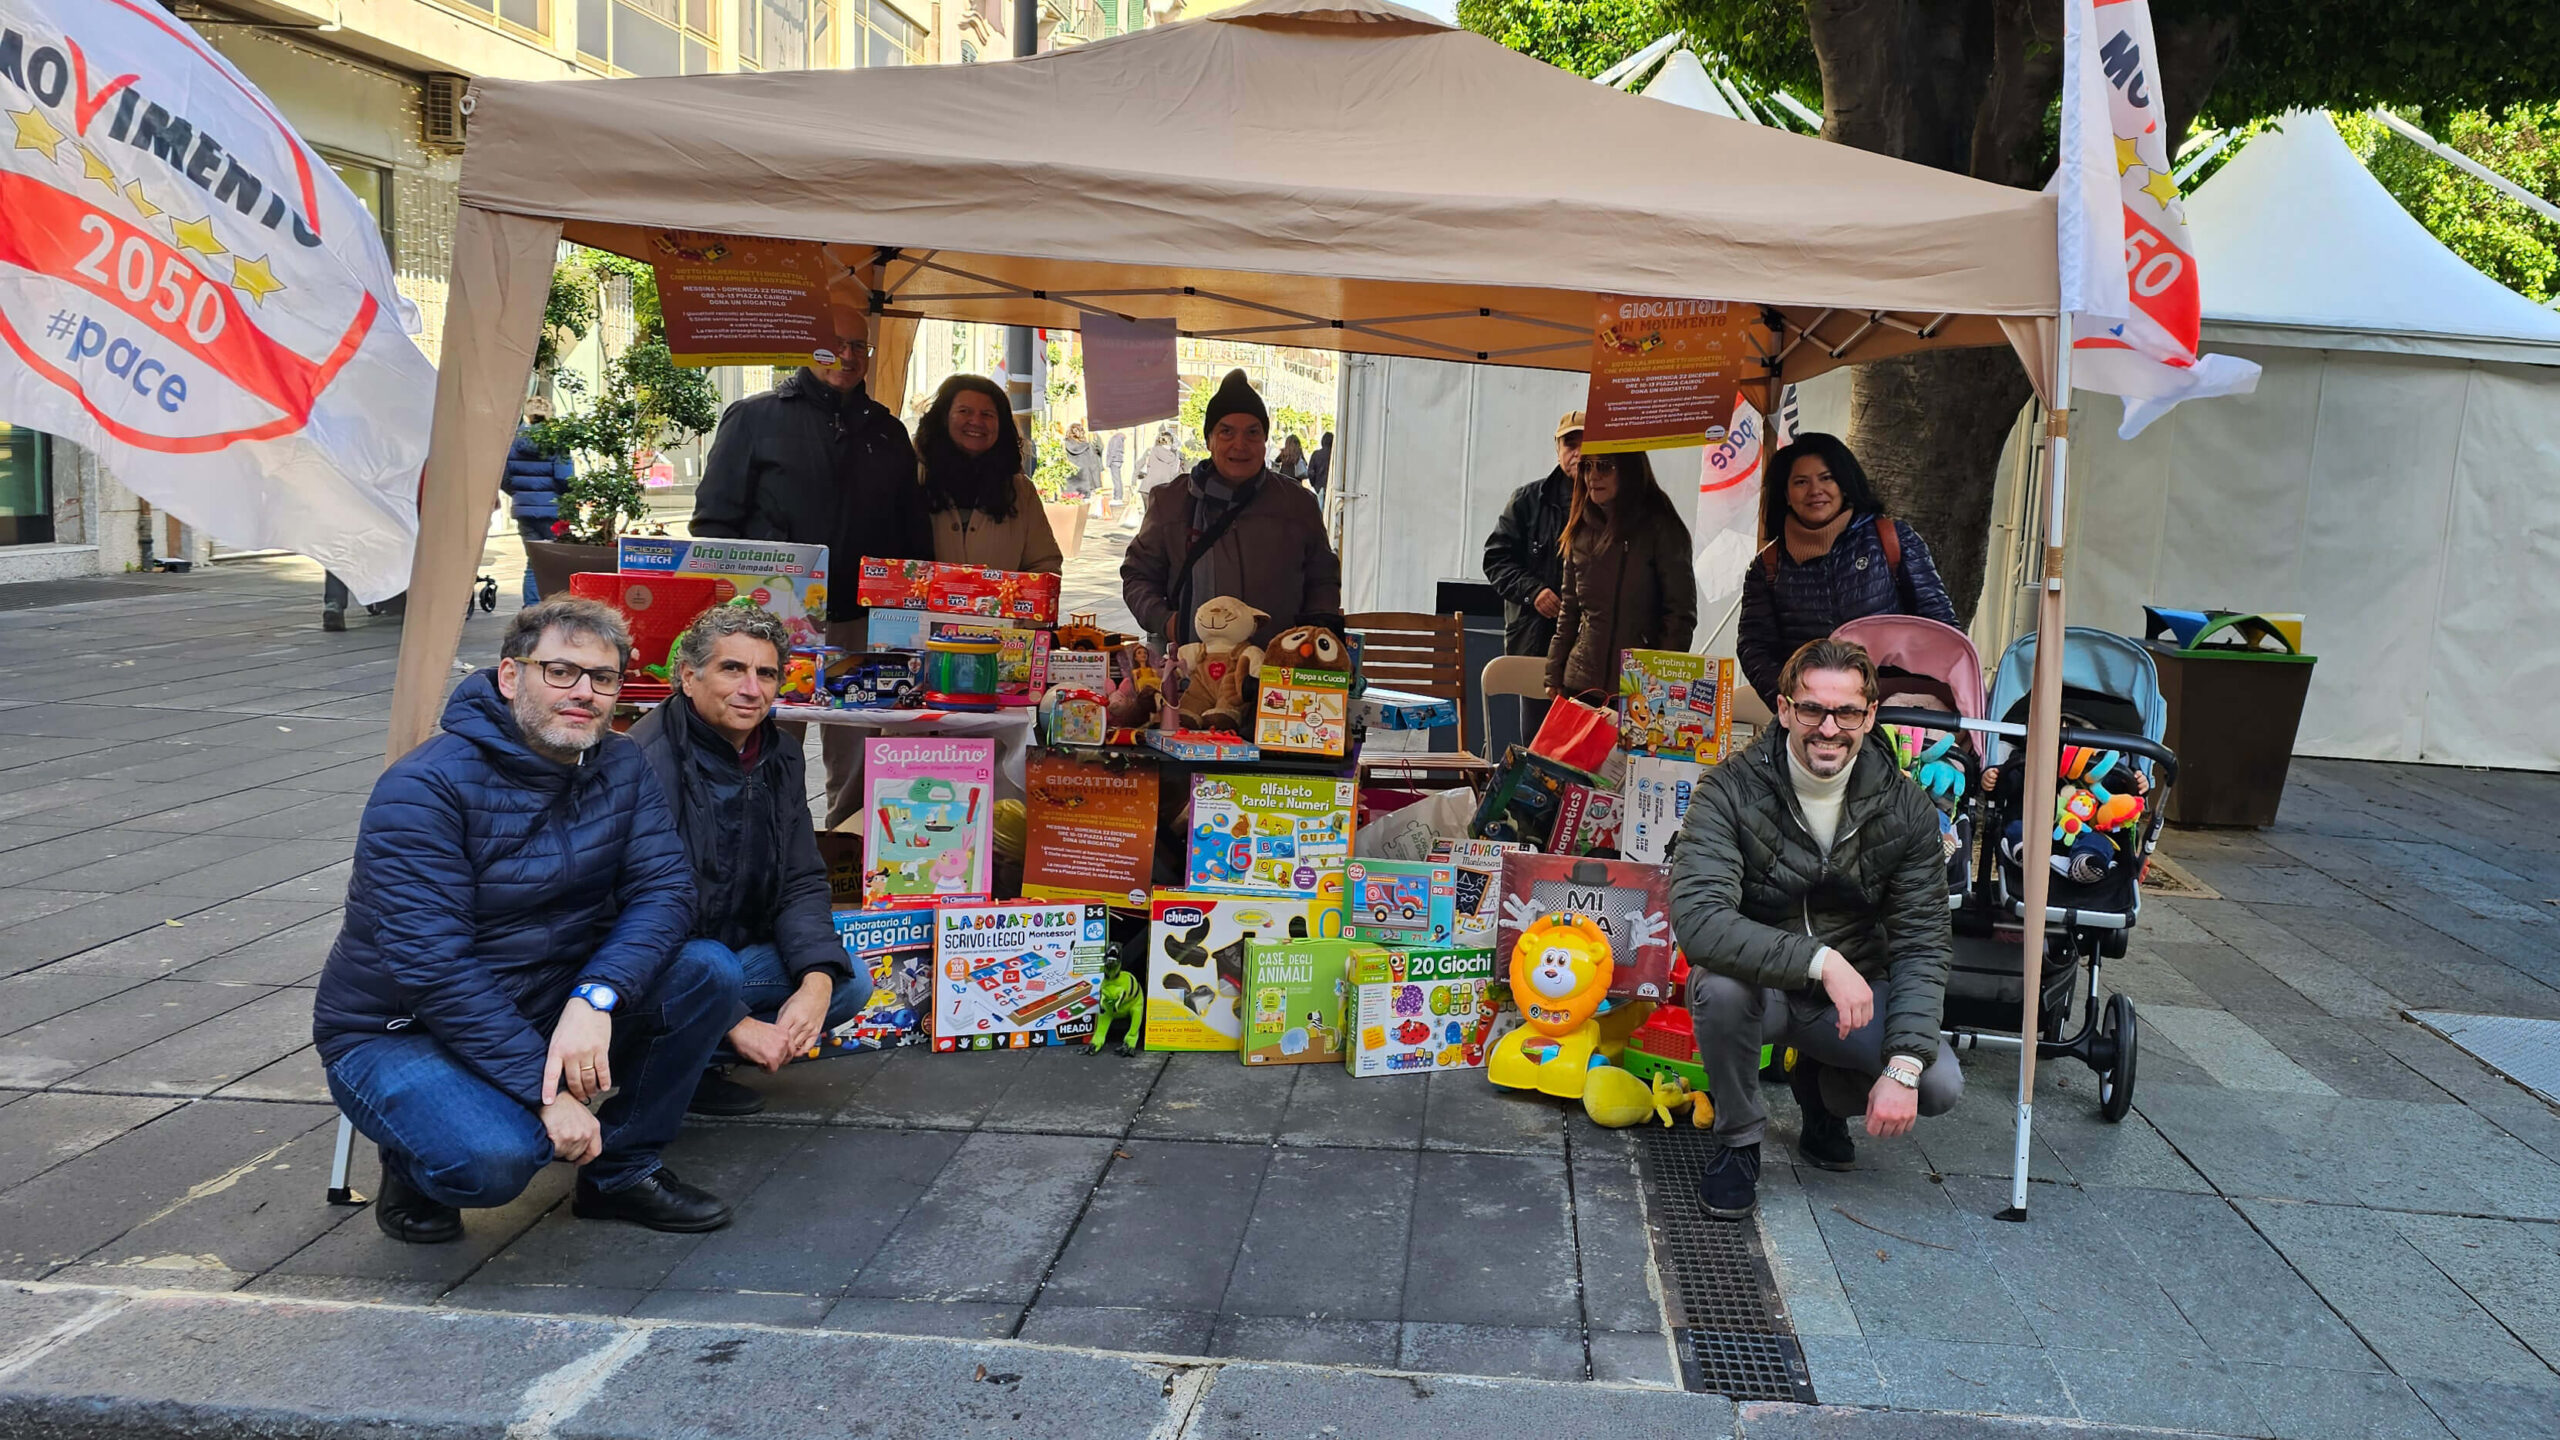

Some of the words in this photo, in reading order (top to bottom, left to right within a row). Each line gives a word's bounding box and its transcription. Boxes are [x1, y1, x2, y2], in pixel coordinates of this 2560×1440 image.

[73, 214, 225, 344] 2050
[1619, 300, 1728, 319] GIOCATTOLI
[1619, 320, 1634, 333] IN
[1640, 315, 1727, 332] MOVIMENTO
[46, 309, 187, 413] #pace
[624, 545, 673, 554] SCIENZA
[692, 545, 722, 559] Orto
[729, 546, 796, 563] botanico
[719, 563, 736, 571] con
[737, 562, 774, 573] lampada
[775, 564, 804, 574] LED
[1049, 654, 1104, 663] SILLABANDO
[1653, 656, 1686, 667] Carotina
[1295, 672, 1317, 681] Pappa
[1322, 674, 1346, 683] Cuccia
[1662, 667, 1692, 680] Londra
[873, 743, 987, 768] Sapientino
[1046, 775, 1139, 789] GIOCATTOLI
[1260, 782, 1313, 798] Alfabeto
[1241, 794, 1277, 808] Parole
[1286, 798, 1329, 811] Numeri
[1234, 843, 1252, 869] 5
[1567, 890, 1605, 912] MI
[1087, 908, 1104, 917] 3-6
[1165, 909, 1200, 924] chicco
[844, 917, 900, 932] Laboratorio
[902, 916, 911, 925] di
[945, 910, 1077, 932] LABORATORIO
[944, 932, 986, 950] SCRIVO
[993, 931, 1026, 948] LEGGO
[1029, 929, 1077, 939] Montessori
[1258, 952, 1285, 966] CASE
[1289, 954, 1313, 965] DEGLI
[1411, 958, 1435, 975] 20
[1438, 954, 1492, 973] Giochi
[1257, 966, 1313, 984] ANIMALI
[1059, 1022, 1093, 1034] HEADU
